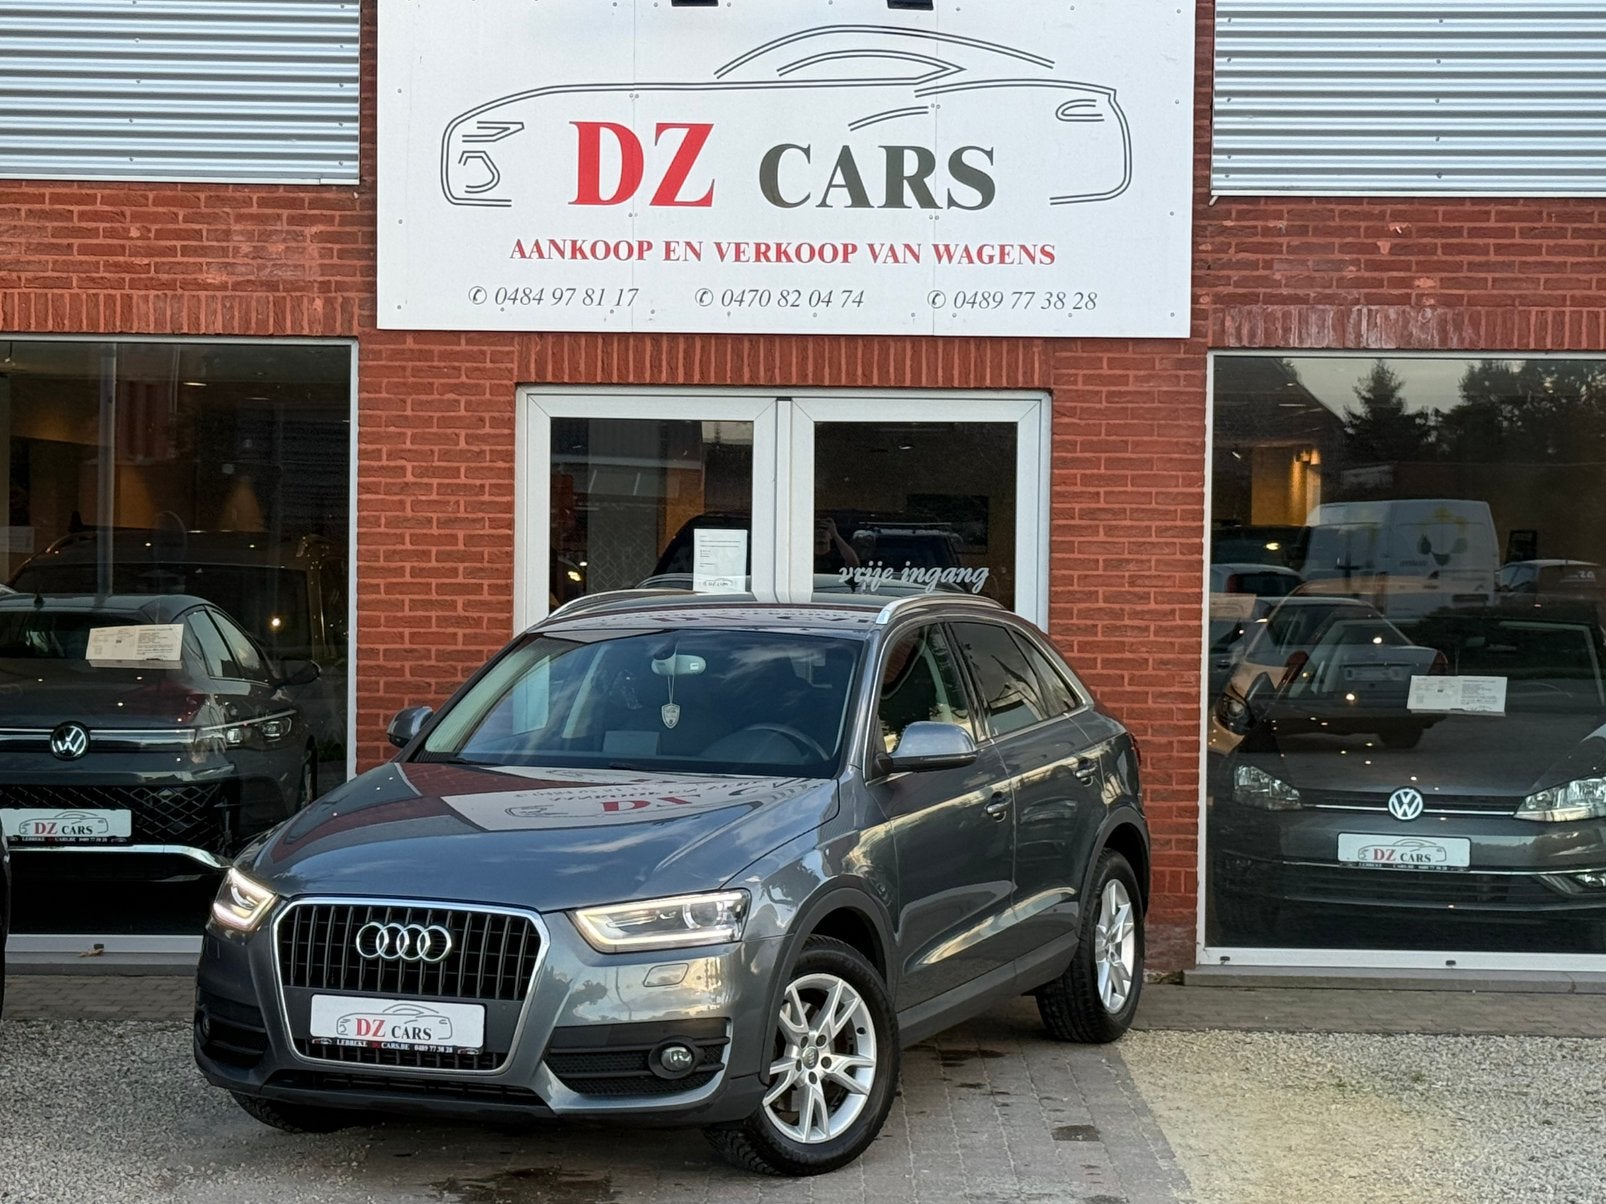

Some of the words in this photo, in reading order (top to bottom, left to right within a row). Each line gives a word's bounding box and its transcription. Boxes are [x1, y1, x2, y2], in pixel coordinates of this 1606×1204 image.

[568, 121, 714, 208] DZ
[759, 143, 996, 211] CARS
[510, 238, 653, 262] AANKOOP
[663, 240, 703, 262] EN
[714, 241, 857, 264] VERKOOP
[867, 243, 922, 264] VAN
[931, 243, 1056, 266] WAGENS
[494, 286, 545, 306] 0484
[551, 287, 576, 306] 97
[582, 287, 606, 307] 81
[614, 287, 640, 307] 17
[721, 289, 772, 308] 0470
[777, 289, 802, 308] 82
[808, 289, 834, 308] 04
[840, 289, 865, 308] 74
[953, 290, 1004, 310] 0489
[1010, 291, 1036, 310] 77
[1040, 291, 1067, 310] 38
[1072, 291, 1098, 310] 28
[838, 560, 894, 592] vrije
[900, 560, 990, 594] ingang
[34, 822, 57, 835] DZ
[61, 825, 93, 835] CARS
[1373, 848, 1396, 861] DZ
[1400, 852, 1432, 863] CARS
[355, 1018, 386, 1037] DZ
[391, 1025, 432, 1040] CARS
